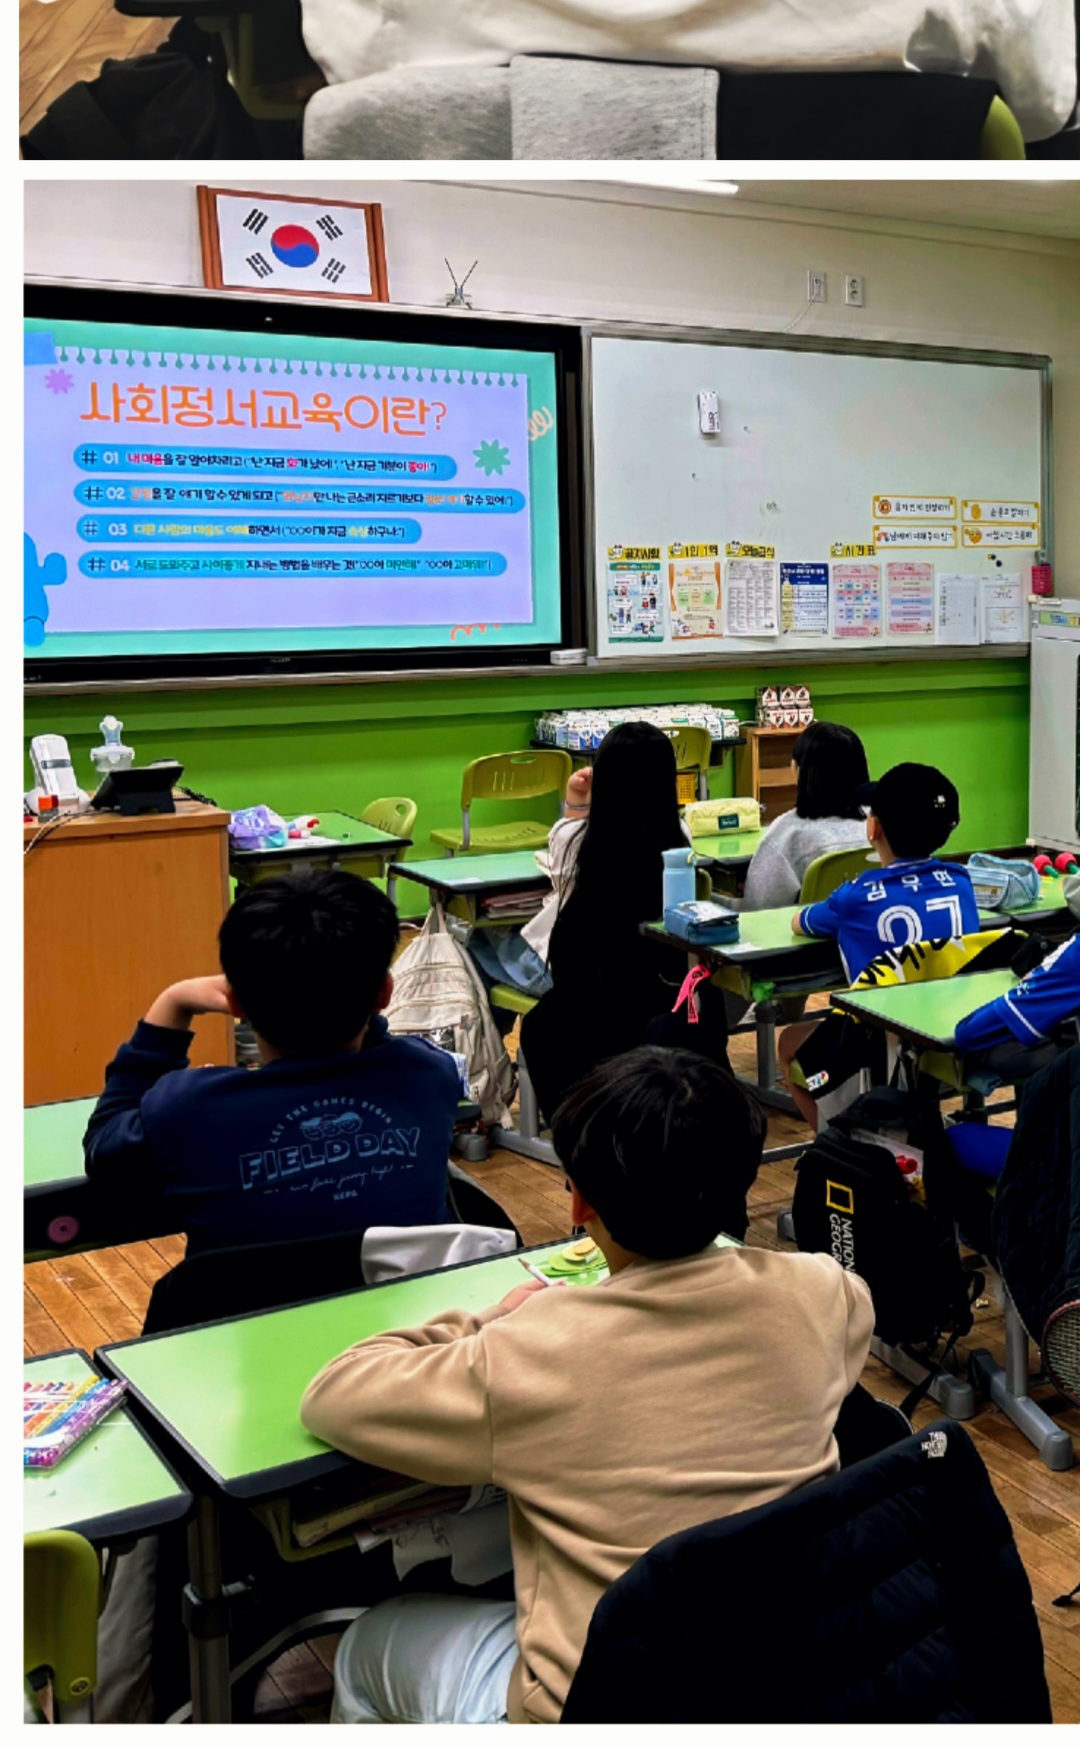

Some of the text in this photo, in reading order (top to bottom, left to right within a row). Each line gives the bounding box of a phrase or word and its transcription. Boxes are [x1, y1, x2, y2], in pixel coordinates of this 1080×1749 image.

[845, 544, 877, 557] 시간표
[863, 869, 957, 902] 김우현
[238, 1139, 351, 1191] FIELD
[354, 1126, 421, 1158] DAY
[829, 1212, 843, 1264] GEOGR
[841, 1217, 856, 1273] NATION
